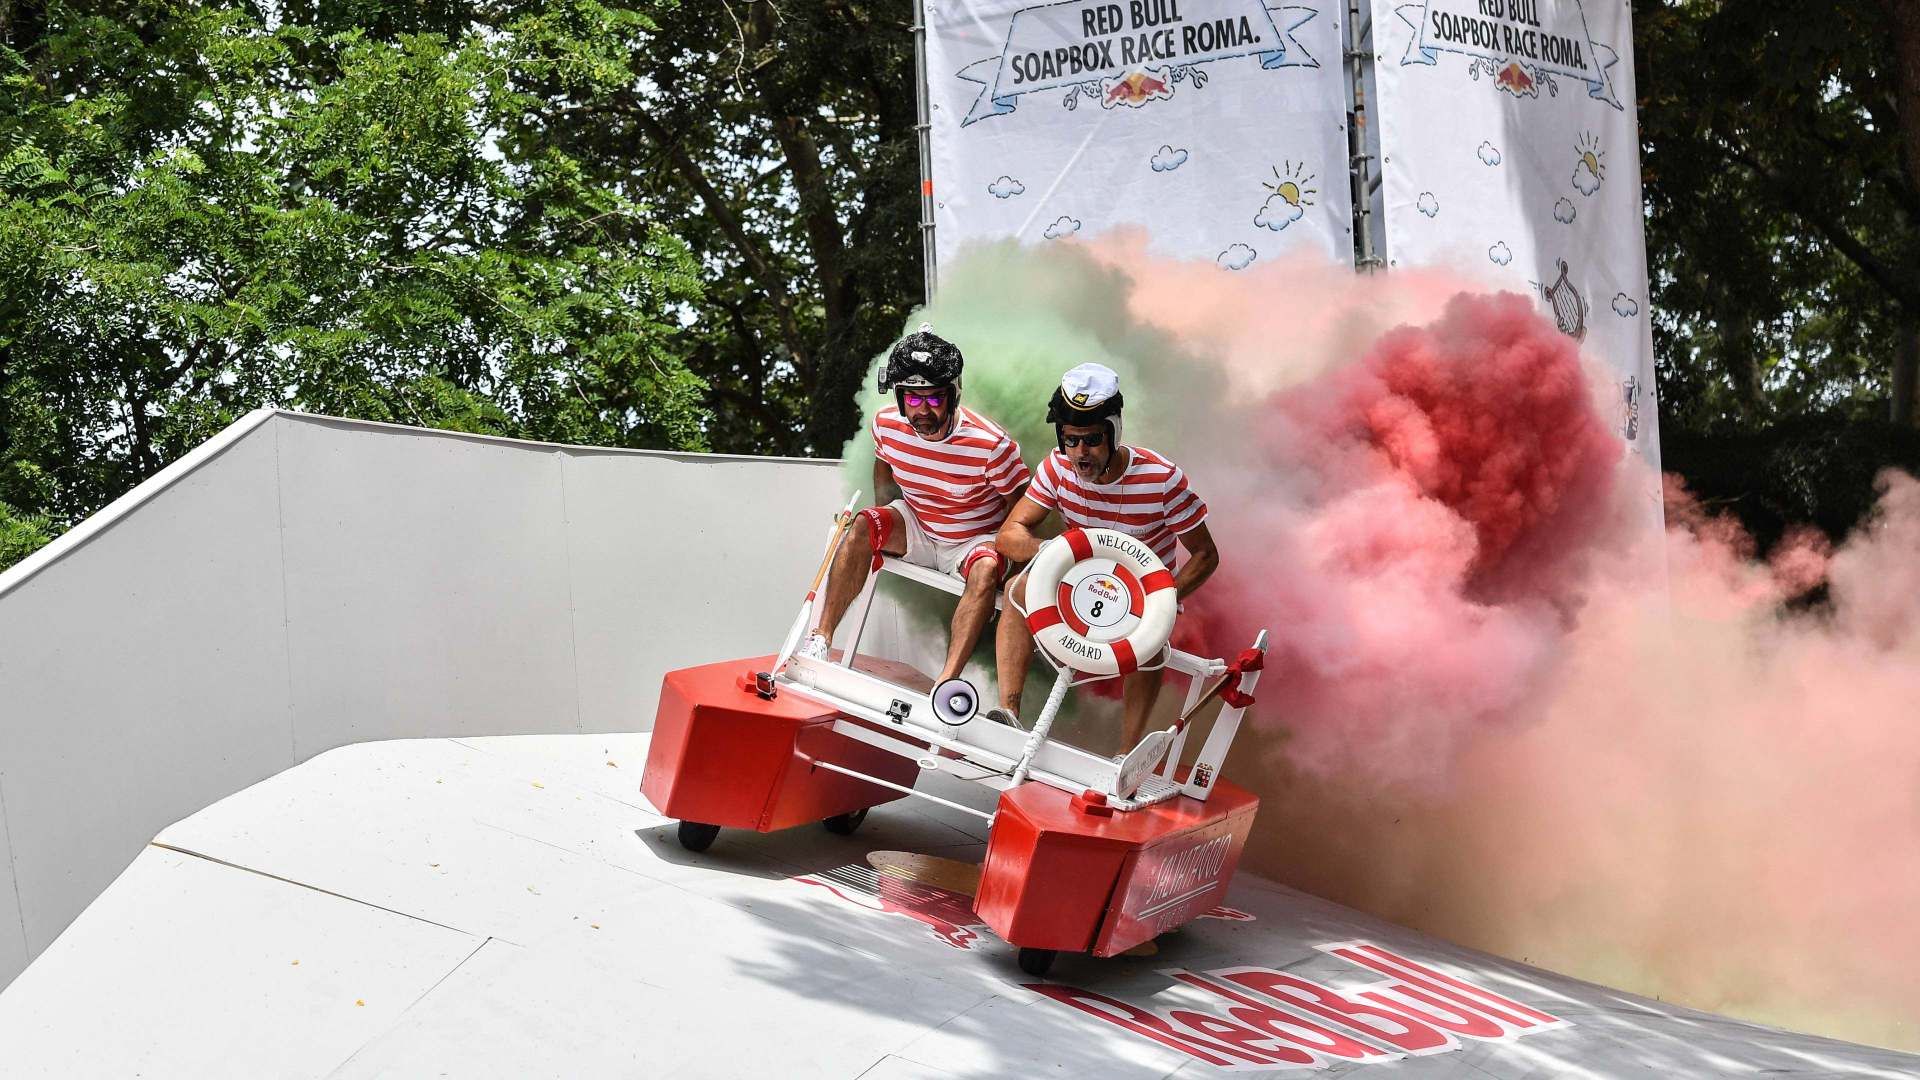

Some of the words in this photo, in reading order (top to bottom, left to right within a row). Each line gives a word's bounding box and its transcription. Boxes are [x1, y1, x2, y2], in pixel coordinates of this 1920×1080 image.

[1081, 4, 1123, 38] RED
[1129, 0, 1183, 30] BULL
[1479, 0, 1504, 18] RED
[1508, 0, 1541, 27] BULL
[1011, 39, 1113, 85] SOAPBOX
[1120, 29, 1175, 66] RACE
[1182, 15, 1261, 54] ROMA.
[1432, 10, 1499, 51] SOAPBOX
[1503, 25, 1538, 59] RACE
[1540, 32, 1588, 70] ROMA.
[1097, 534, 1152, 567] WELCOME
[1088, 584, 1104, 596] Red
[1103, 590, 1118, 603] Bull
[1090, 601, 1104, 618] 8
[1059, 635, 1102, 660] ABOARD
[1019, 973, 1387, 1066] Red
[1220, 944, 1560, 1051] Bull
